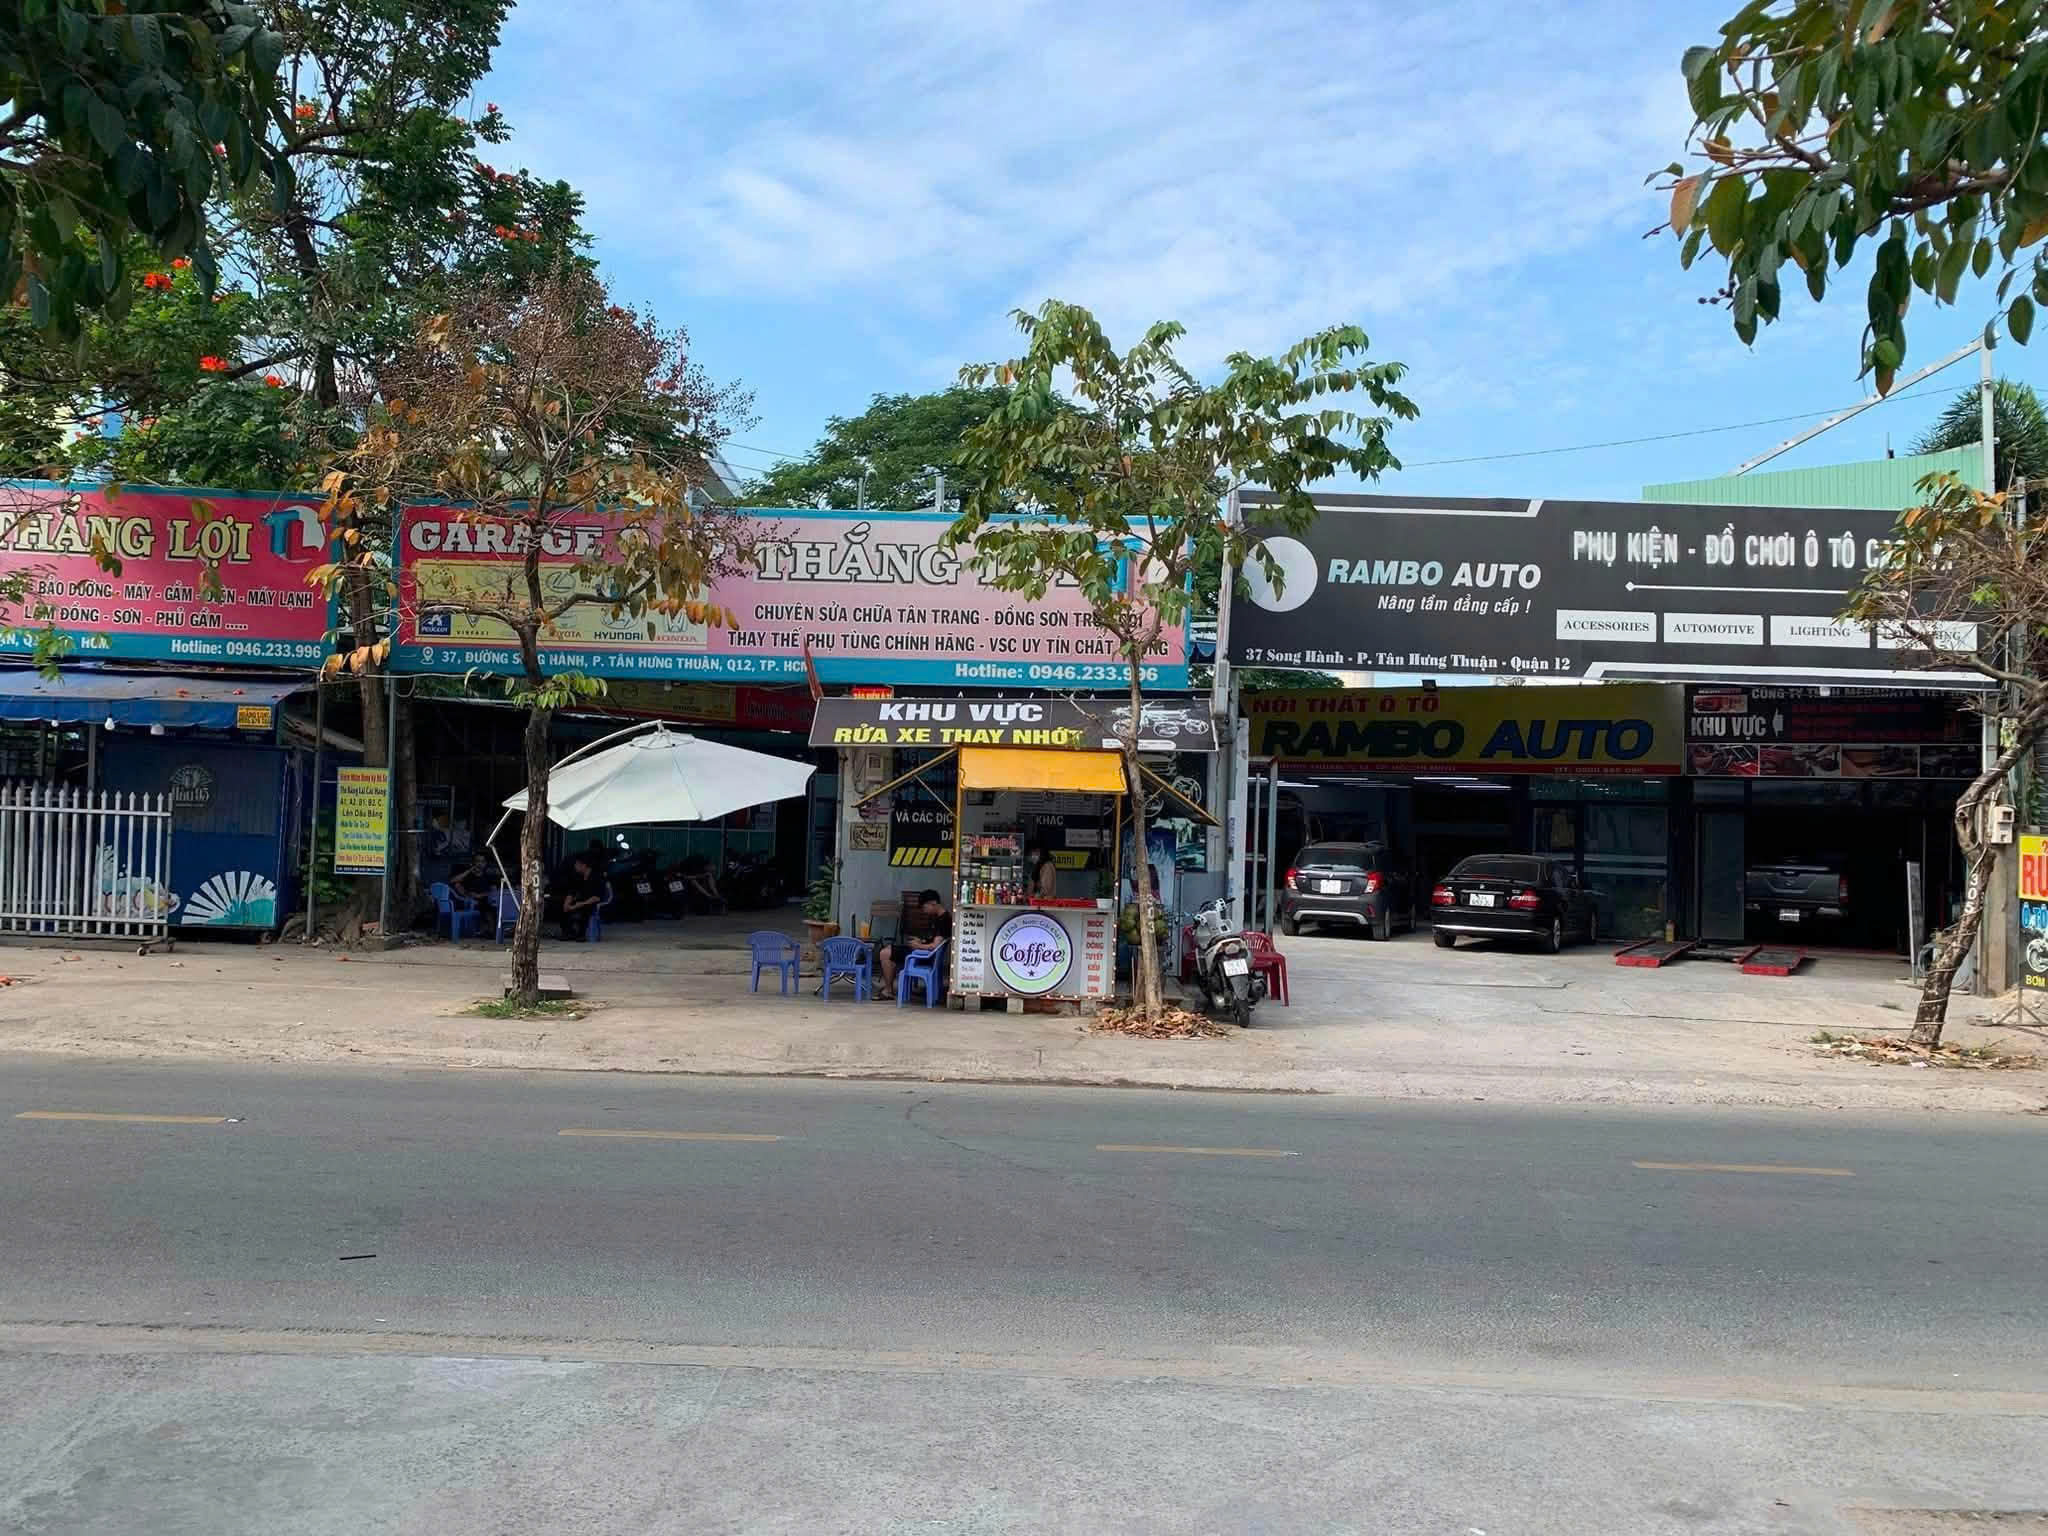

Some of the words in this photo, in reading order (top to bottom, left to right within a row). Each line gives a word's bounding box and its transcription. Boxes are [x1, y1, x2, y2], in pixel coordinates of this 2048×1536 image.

[169, 518, 252, 567] LỢI
[1573, 530, 1617, 567] PHỤ
[1627, 525, 1678, 569] KIỆN
[1705, 523, 1735, 565] ĐỒ
[1745, 531, 1795, 566] CHƠI
[1804, 529, 1819, 567] Ô
[1828, 531, 1855, 568] TÔ
[1327, 558, 1443, 586] RAMBO
[1451, 562, 1542, 589] AUTO
[125, 581, 152, 600] MÁY
[248, 586, 275, 605] MÁY
[279, 591, 313, 609] LẠNH
[1377, 594, 1414, 612] Nâng
[1494, 596, 1519, 615] cấp
[61, 601, 99, 622] ĐỒNG
[113, 608, 141, 624] SƠN
[156, 607, 184, 626] PHỦ
[755, 602, 814, 621] CHUYÊN
[819, 601, 848, 622] SỬA
[853, 605, 892, 623] CHỮA
[897, 606, 927, 624] TÂN
[931, 608, 980, 626] TRANG
[995, 604, 1034, 626] ĐỒNG
[1040, 610, 1068, 627] SƠN
[594, 631, 643, 640] HYUNDAI
[1564, 620, 1649, 632] ACCESSORIES
[1673, 623, 1754, 635] AUTOMOTIVE
[1790, 626, 1850, 637] LIGHTING
[172, 640, 222, 655] Hotline:
[226, 642, 320, 658] 0946.233.996
[728, 631, 766, 646] THAY
[771, 627, 801, 647] THẾ
[806, 633, 835, 651] PHỤ
[841, 631, 880, 649] TÙNG
[885, 632, 929, 650] CHÍNH
[990, 638, 1016, 653] VSC
[1023, 639, 1041, 653] UY
[1046, 636, 1070, 654] TÍN
[442, 652, 460, 664] 37,
[465, 650, 508, 665] ĐƯỜNG
[512, 652, 545, 665] SG
[592, 656, 604, 666] P.
[609, 655, 634, 667] TÂN
[638, 656, 672, 669] HƯNG
[677, 656, 723, 672] THUẬN,
[727, 659, 755, 672] Q12,
[760, 660, 779, 671] TP.
[955, 663, 1022, 679] Hotline:
[1246, 648, 1263, 661] 37
[1266, 649, 1301, 665] Song
[1305, 648, 1344, 664] Hành
[1357, 652, 1372, 664] P.
[1376, 653, 1404, 665] Tân
[1408, 653, 1447, 669] Hưng
[1450, 654, 1498, 671] Thuận
[1510, 656, 1548, 672] Quận
[1554, 657, 1570, 670] 12
[879, 703, 956, 720] KHU
[969, 703, 1043, 725] VỰC
[834, 723, 888, 743] RỬA
[896, 728, 935, 743] XE
[940, 728, 1004, 744] THAY
[1690, 717, 1726, 736] KHU
[1732, 714, 1767, 740] VỰC
[1262, 720, 1465, 757] RAMBO
[1479, 719, 1654, 760] AUTO
[1964, 873, 1979, 913] 305
[1000, 943, 1065, 967] Coffee
